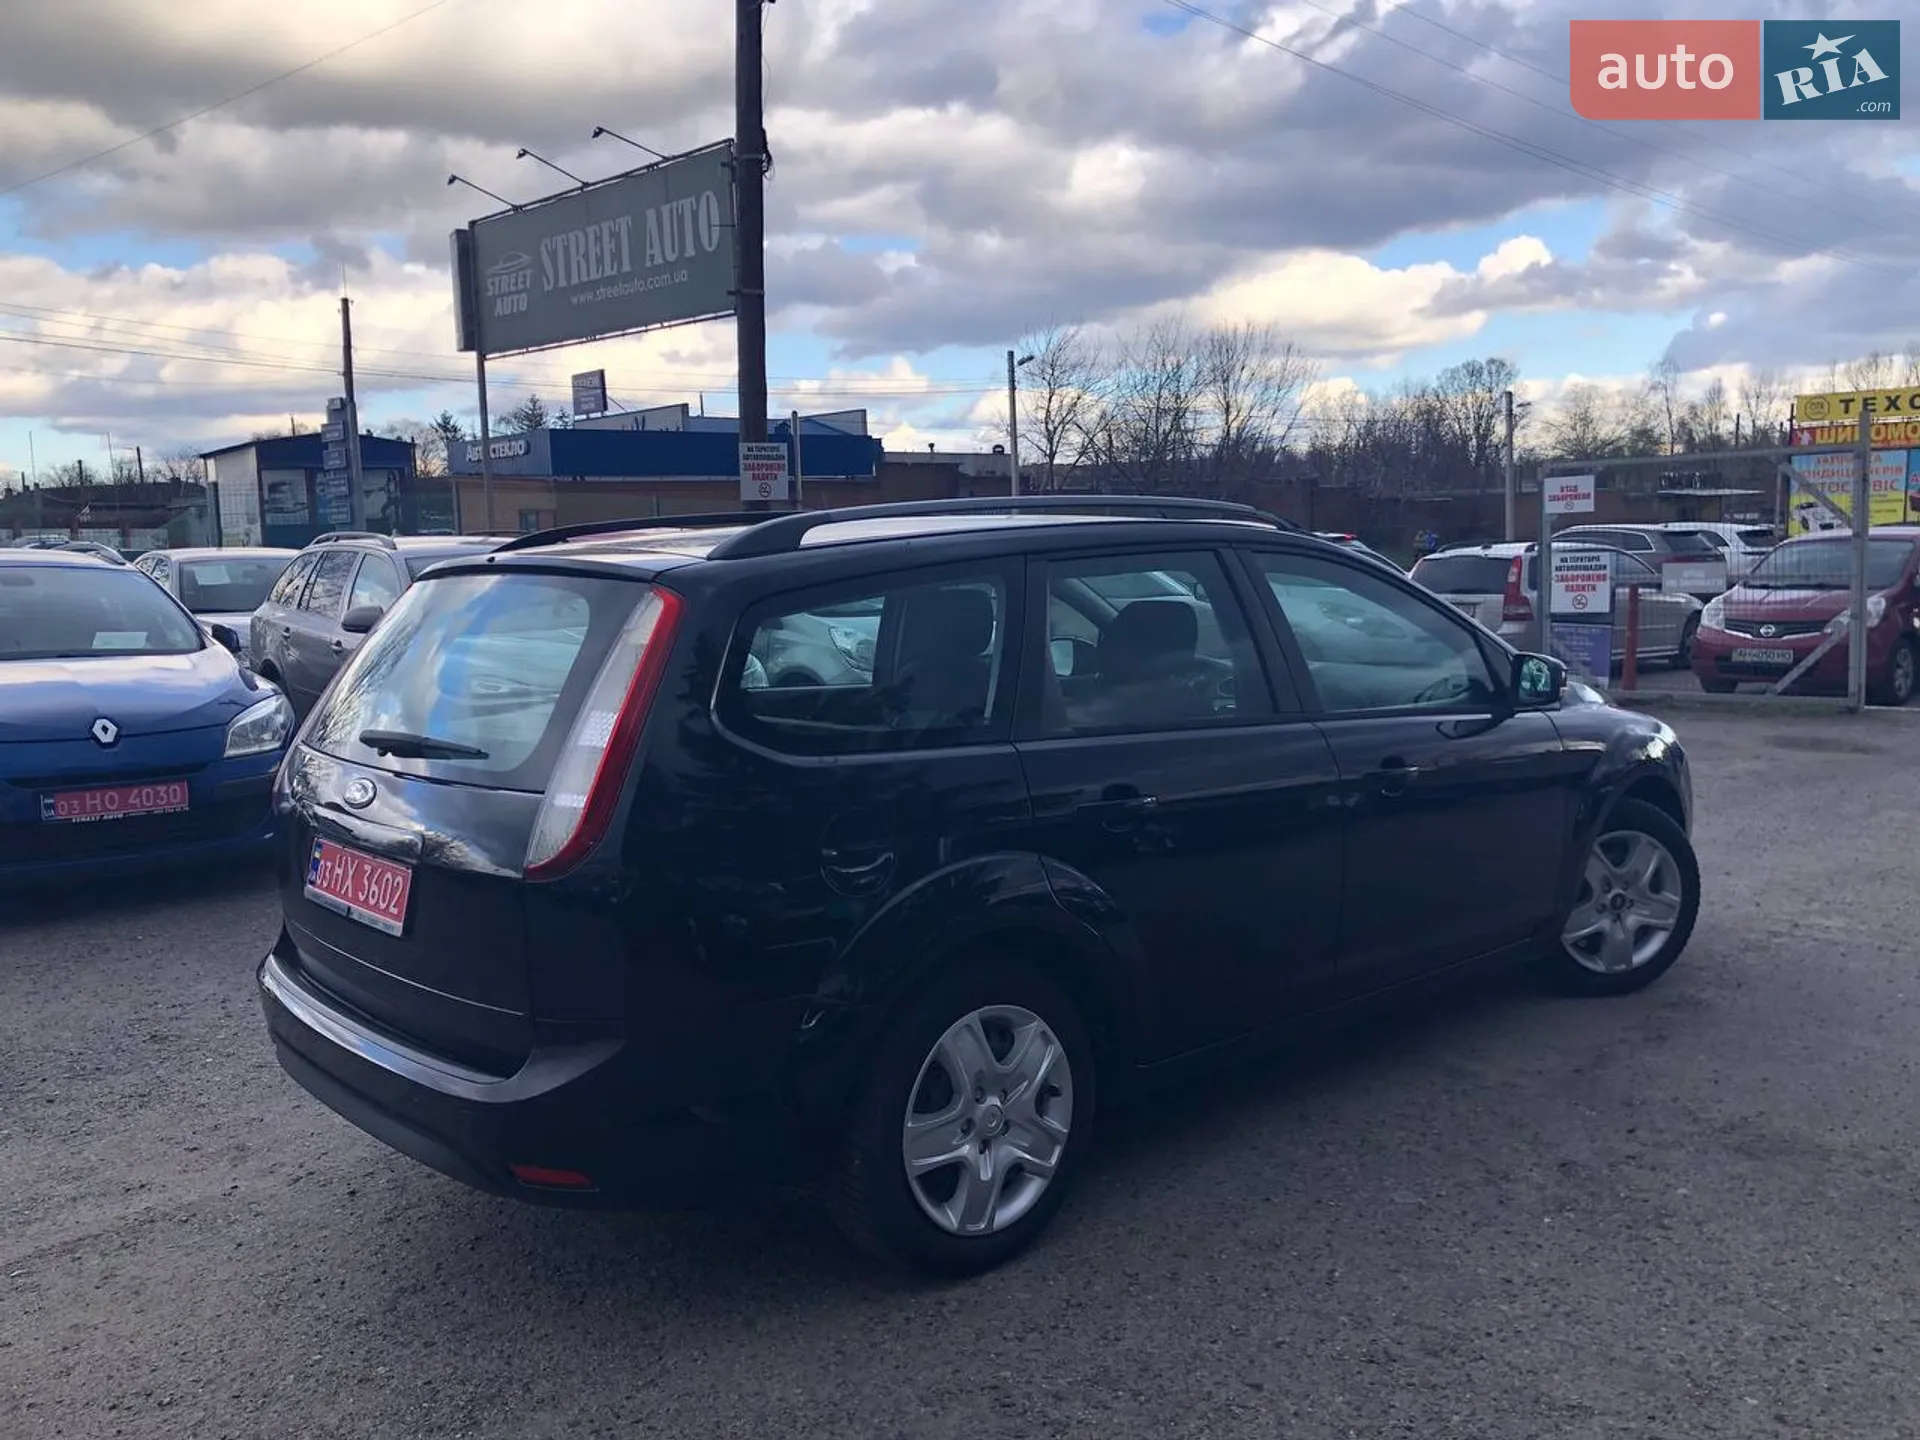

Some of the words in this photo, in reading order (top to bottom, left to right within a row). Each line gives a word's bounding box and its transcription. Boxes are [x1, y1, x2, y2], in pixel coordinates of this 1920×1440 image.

[540, 215, 633, 292] STREET
[644, 190, 720, 268] AUTO
[486, 269, 533, 297] STREET
[571, 268, 688, 306] www.streetauto.com.ua
[494, 293, 528, 318] AUTO
[1555, 573, 1608, 583] ЗАБОРОНЕНО
[58, 801, 81, 815] 03
[128, 785, 181, 808] 4030
[316, 859, 332, 889] 03
[331, 854, 359, 898] HX
[358, 864, 404, 915] 3602
